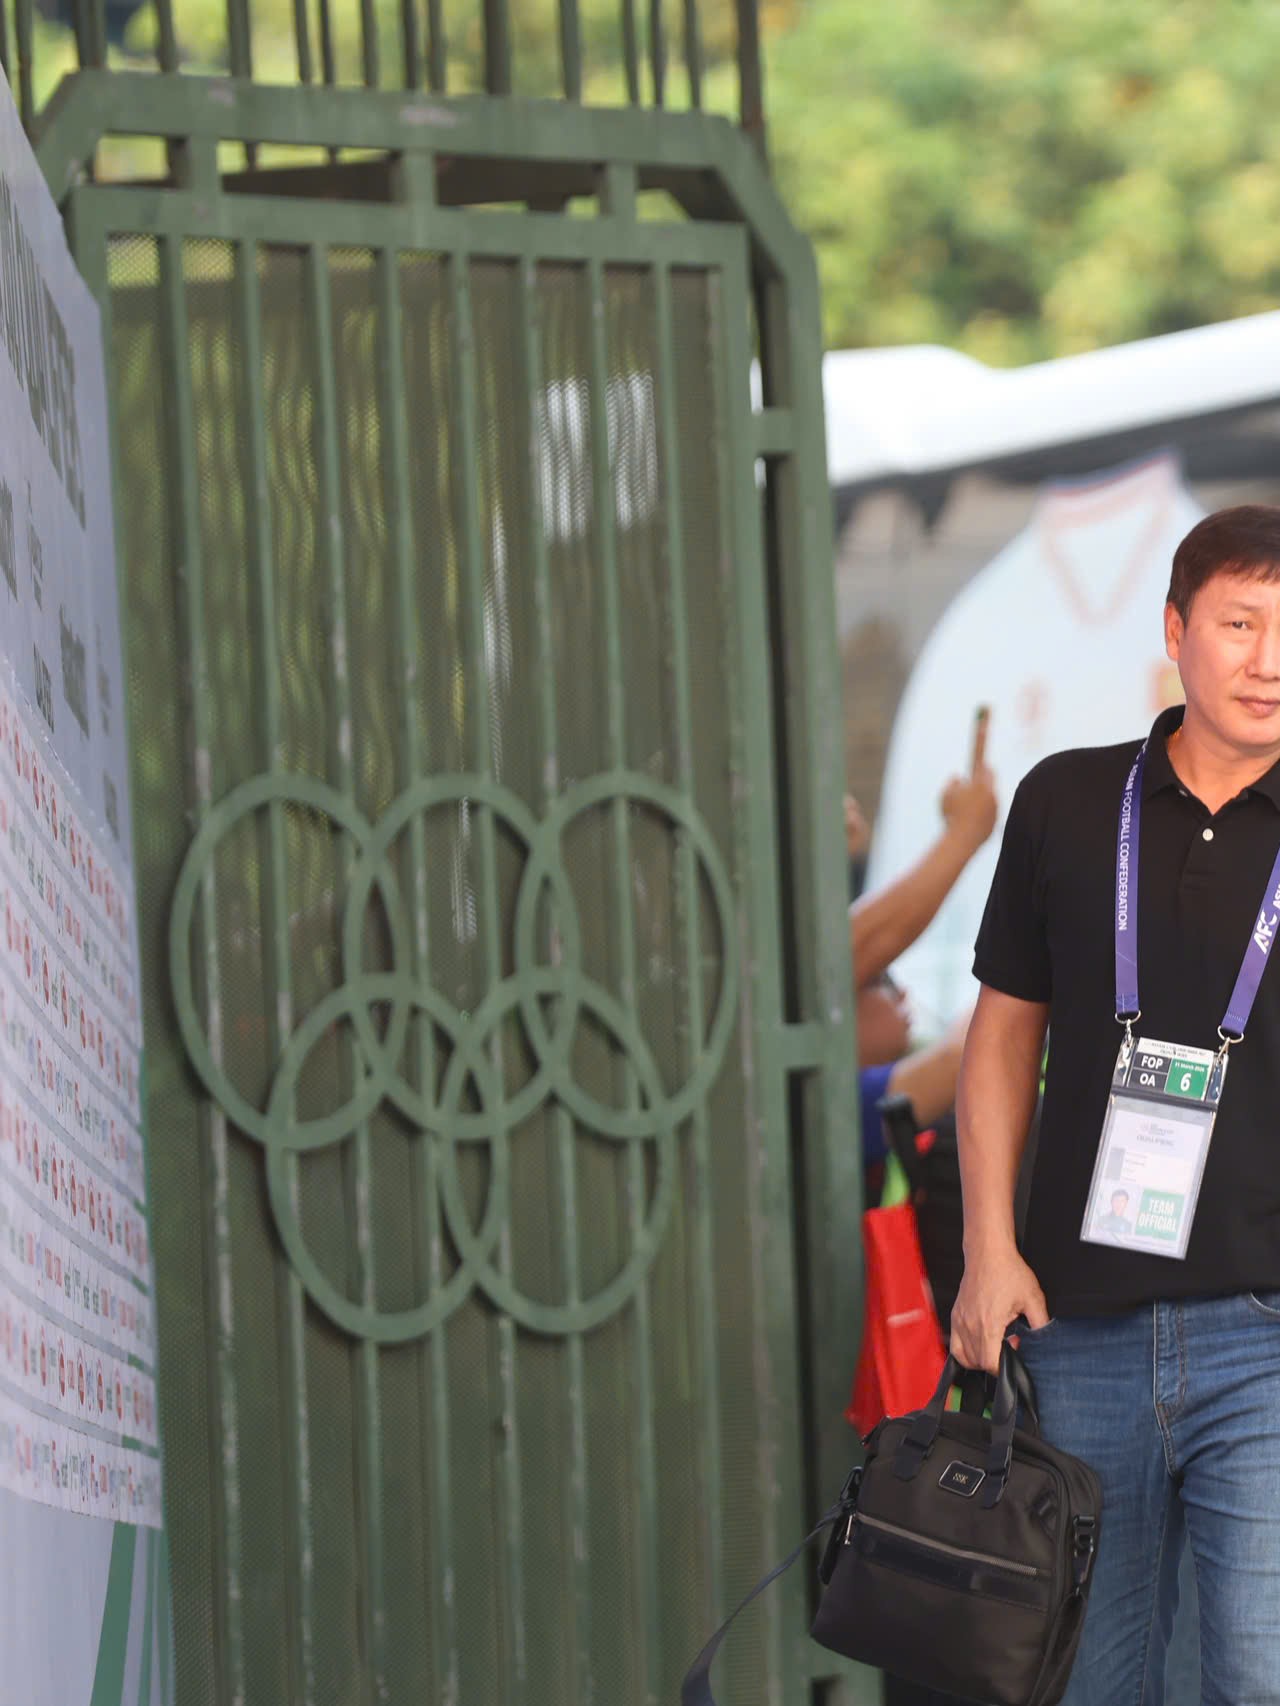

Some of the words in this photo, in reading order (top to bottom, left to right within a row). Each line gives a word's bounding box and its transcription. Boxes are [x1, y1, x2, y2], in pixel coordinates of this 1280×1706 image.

[1120, 791, 1133, 841] FOOTBALL
[1117, 842, 1130, 931] CONFEDERATION
[1253, 910, 1278, 954] AFC
[1141, 1055, 1164, 1070] FOP
[1139, 1072, 1156, 1087] OA
[1180, 1072, 1192, 1092] 6
[1149, 1198, 1175, 1216] TEAM
[1139, 1212, 1177, 1232] OFFICIAL
